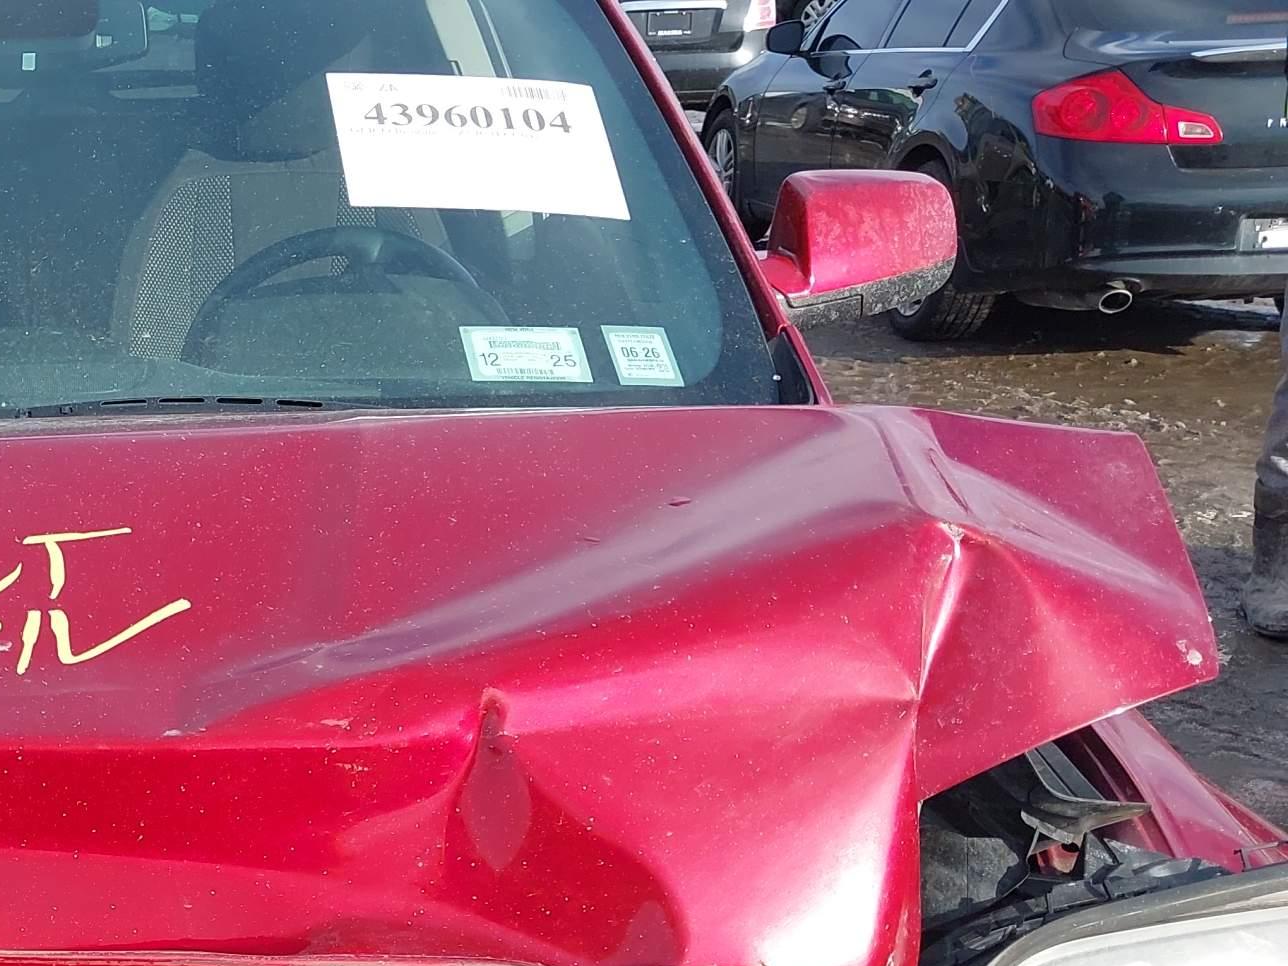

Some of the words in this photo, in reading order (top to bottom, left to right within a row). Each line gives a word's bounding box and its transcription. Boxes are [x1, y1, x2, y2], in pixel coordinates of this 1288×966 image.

[364, 102, 572, 134] 43960104
[480, 352, 501, 367] 12
[550, 354, 577, 367] 25
[621, 347, 638, 358] 06
[642, 347, 660, 358] 26
